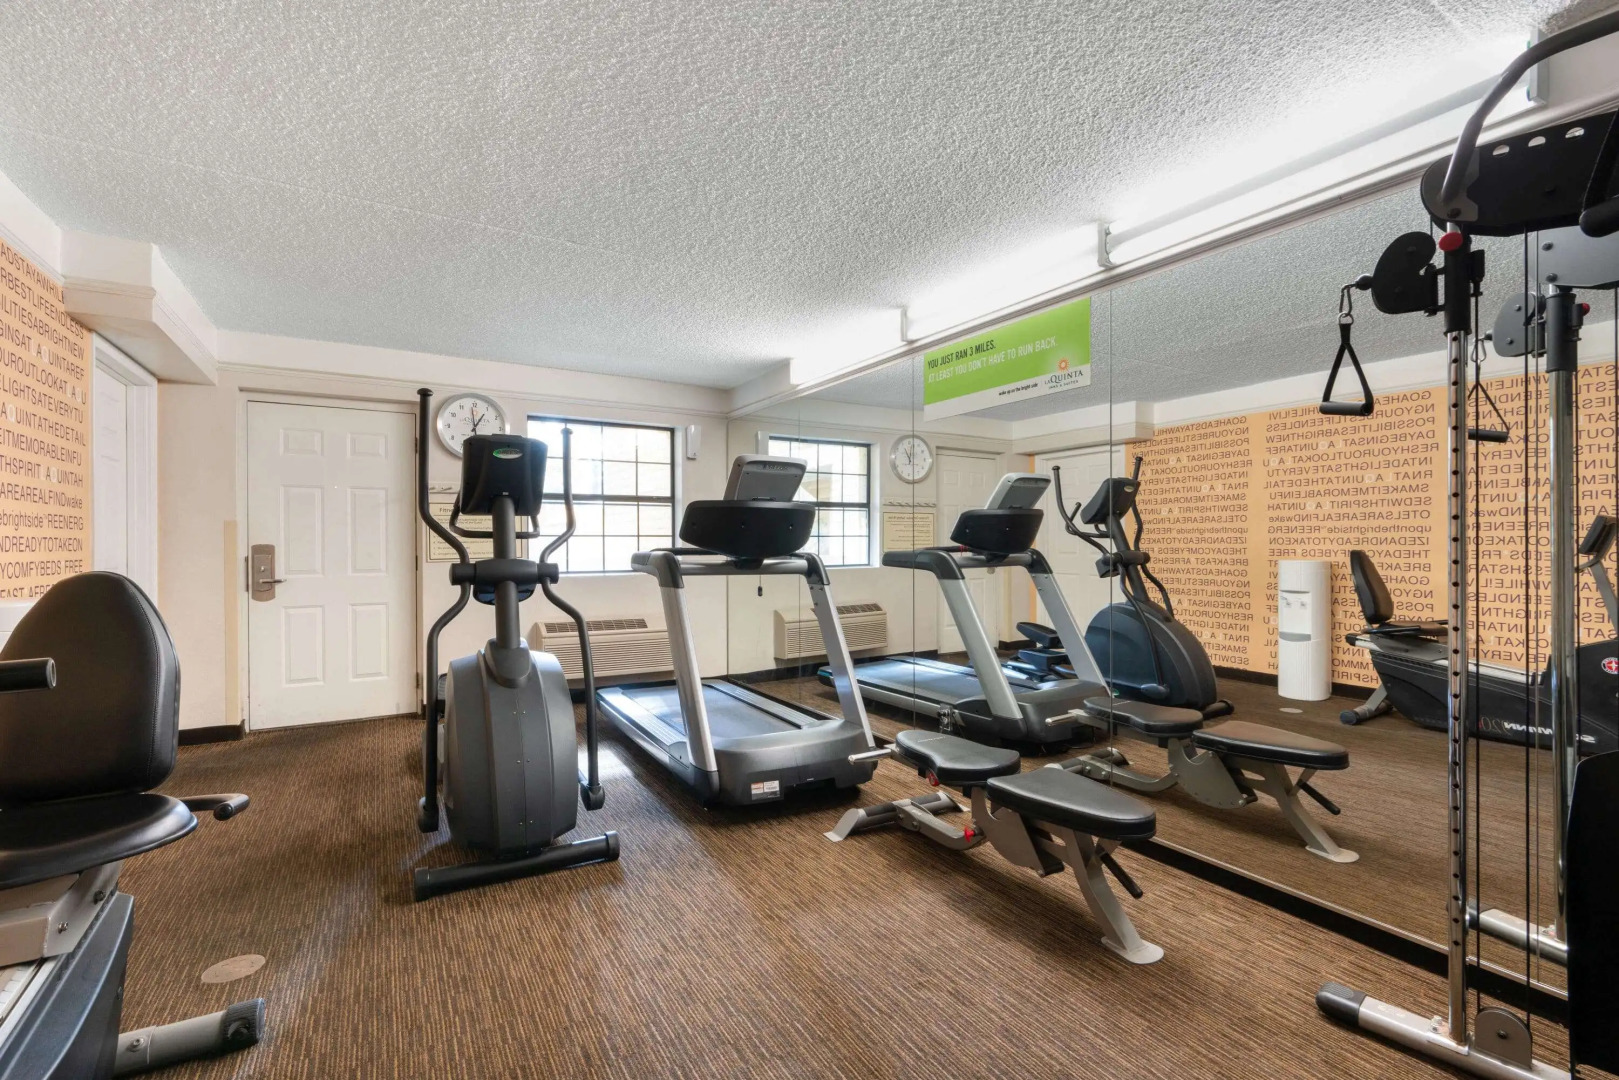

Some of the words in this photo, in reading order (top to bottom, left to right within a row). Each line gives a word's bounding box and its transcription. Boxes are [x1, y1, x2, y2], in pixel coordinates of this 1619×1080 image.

[928, 358, 939, 370] YOU
[940, 354, 953, 366] JUST
[955, 348, 968, 360] RAN
[969, 346, 974, 356] 3
[975, 339, 996, 355] MILES.
[928, 372, 935, 384] AT
[936, 368, 953, 381] LEAST
[955, 363, 967, 375] YOU
[989, 353, 1005, 366] HAVE
[1007, 349, 1016, 360] TO
[1018, 344, 1034, 356] RUN
[1050, 370, 1084, 384] QUINTA
[64, 559, 83, 574] FREE
